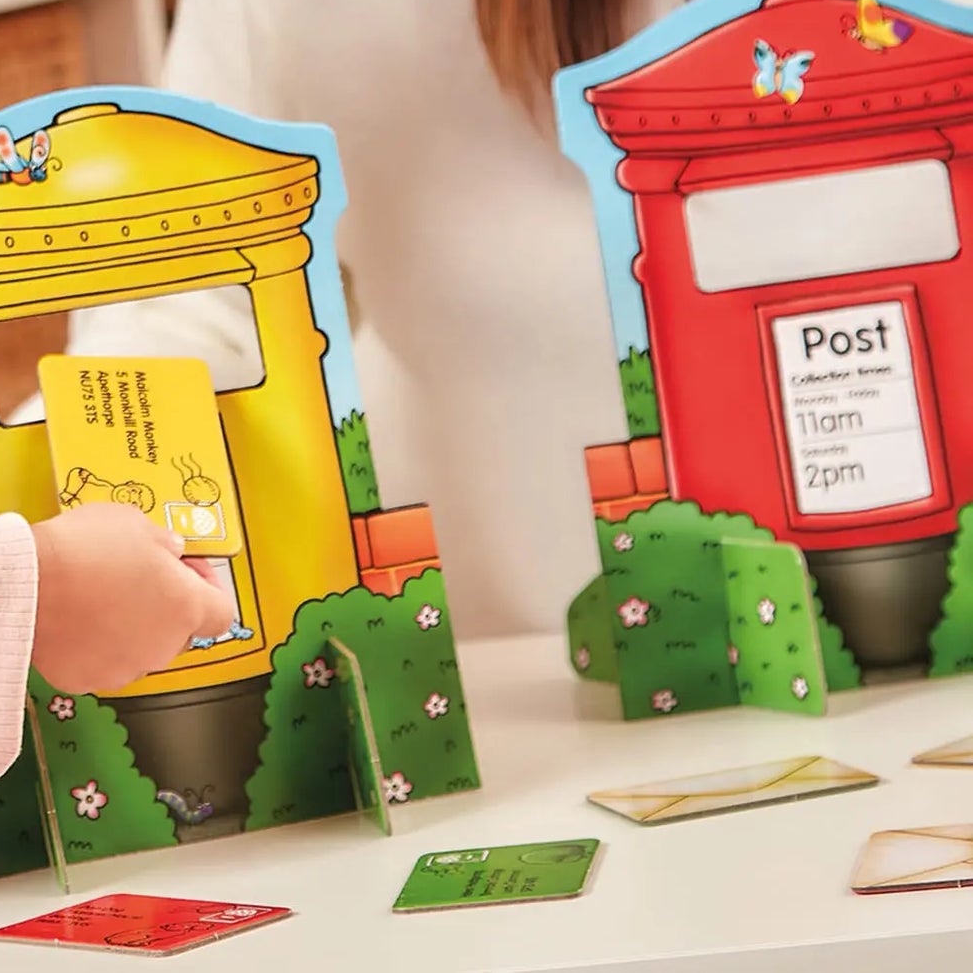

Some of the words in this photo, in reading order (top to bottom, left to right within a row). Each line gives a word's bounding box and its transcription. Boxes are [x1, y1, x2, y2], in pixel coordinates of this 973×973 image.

[802, 319, 889, 359] Post
[79, 370, 95, 401] NU75
[96, 370, 115, 427] Apethorpe
[117, 381, 137, 427] Monkhill
[134, 371, 152, 418] Malcolm
[143, 421, 159, 465] Monkey
[796, 411, 864, 435] 11am
[125, 430, 142, 459] Road
[804, 462, 865, 491] 2pm
